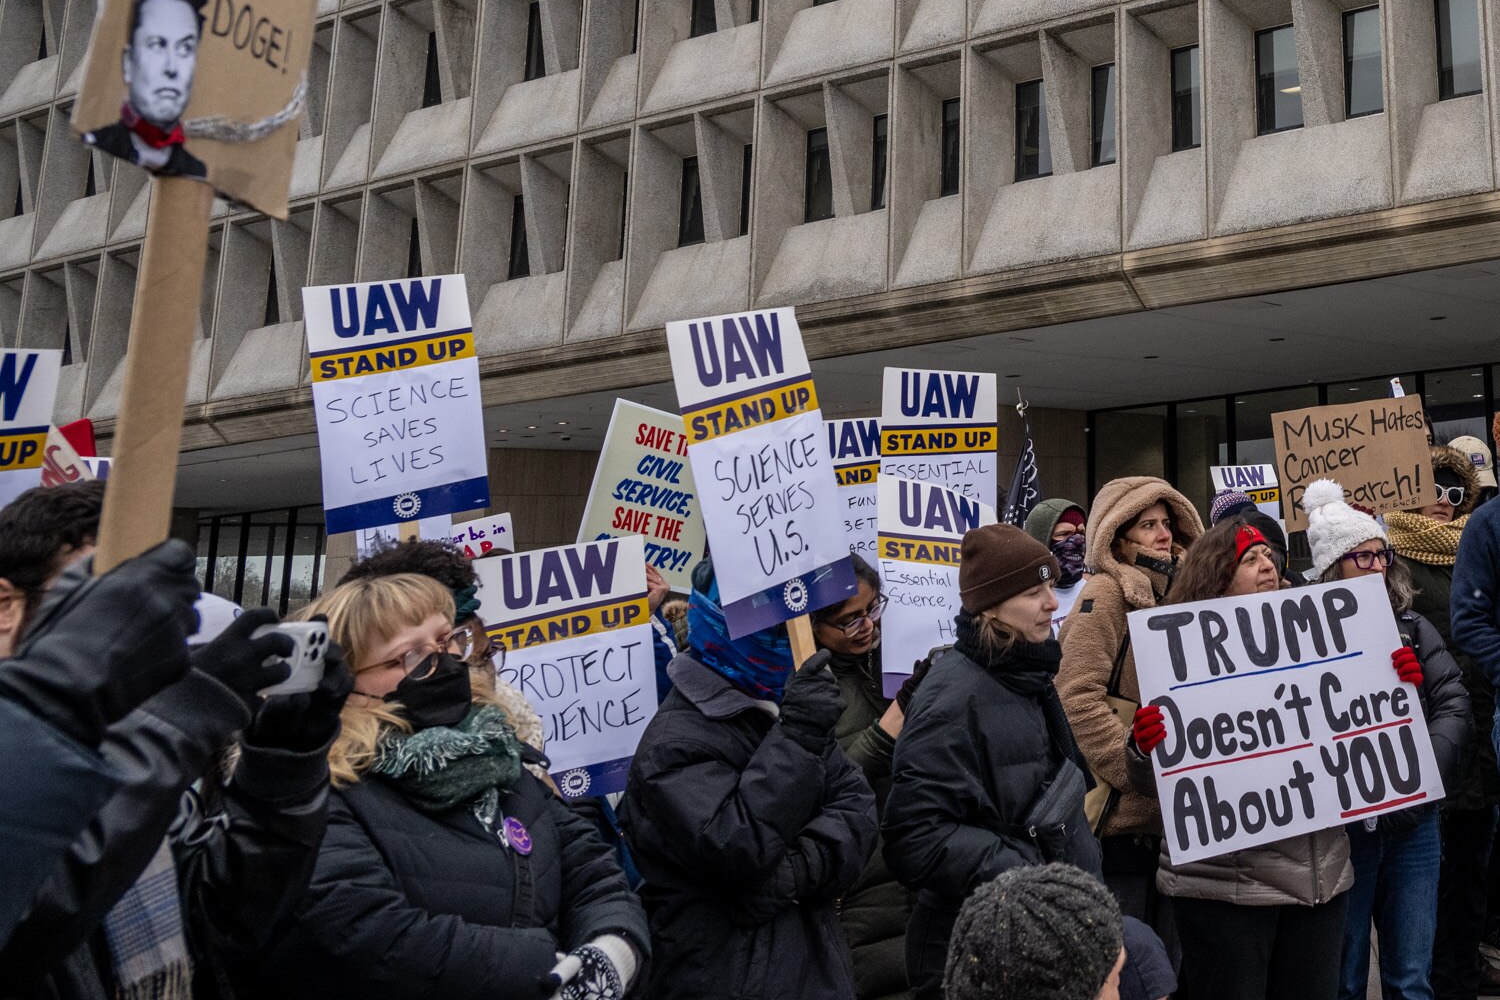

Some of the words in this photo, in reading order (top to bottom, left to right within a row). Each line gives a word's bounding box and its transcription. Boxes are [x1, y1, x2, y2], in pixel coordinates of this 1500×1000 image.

[330, 278, 442, 338] UAW
[320, 347, 418, 378] STAND
[427, 338, 466, 361] UP
[688, 312, 785, 387] UAW
[326, 377, 468, 424] SCIENCE
[691, 397, 776, 441] STAND
[784, 387, 811, 414] UP
[901, 371, 980, 419] UAW
[363, 417, 437, 448] SAVES
[635, 423, 675, 452] SAVE
[1370, 405, 1423, 436] Hates
[887, 433, 957, 451] STAND
[965, 431, 991, 448] UP
[350, 445, 444, 484] LIVES
[637, 454, 684, 484] CIVIL
[714, 433, 818, 501] SCIENCE
[884, 459, 989, 480] ESSENTIAL
[1220, 465, 1265, 488] UAW
[1284, 445, 1365, 484] Cancer
[612, 478, 694, 518] SERVICE,
[736, 481, 815, 534] SERVES
[848, 495, 877, 510] FUN
[899, 480, 980, 534] UAW
[1260, 490, 1276, 501] UP
[468, 526, 486, 540] be
[492, 524, 506, 535] in
[612, 506, 653, 535] SAVE
[655, 515, 685, 542] THE
[754, 520, 809, 576] U.S.
[885, 541, 961, 566] STAND
[501, 541, 619, 610] UAW
[882, 561, 952, 586] Essential
[889, 587, 952, 610] Science,
[488, 615, 591, 650] STAND
[601, 604, 641, 628] UP
[1147, 588, 1358, 682] TRUMP
[1148, 682, 1312, 768] Doesn't
[1320, 672, 1410, 733] Care
[1173, 760, 1315, 851] About
[1320, 725, 1421, 811] YOU
